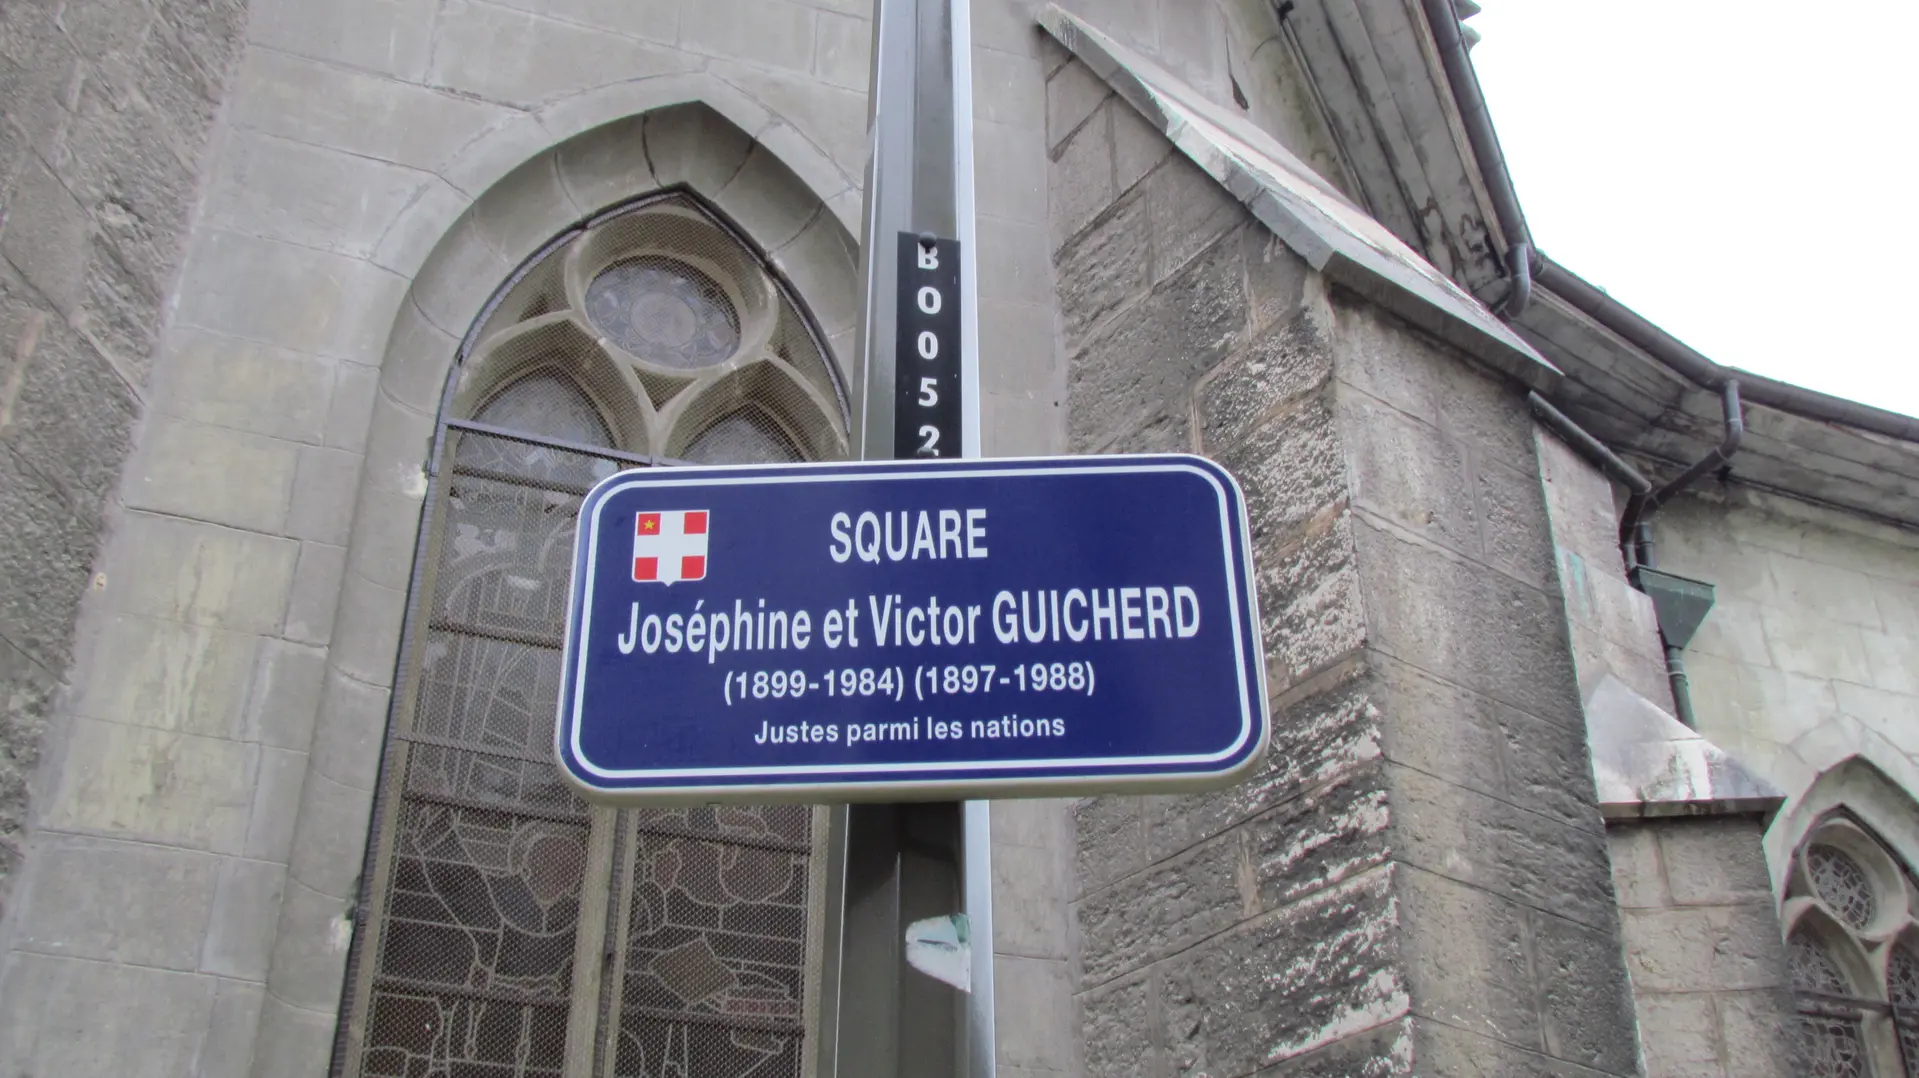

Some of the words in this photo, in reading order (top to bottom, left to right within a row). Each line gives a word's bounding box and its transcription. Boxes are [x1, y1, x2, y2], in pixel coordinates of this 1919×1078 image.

[829, 508, 988, 565] SQUARE
[617, 598, 811, 664] Joséphine
[823, 598, 859, 649] et
[869, 594, 981, 647] Victor
[992, 586, 1201, 644] GUICHERD
[724, 666, 904, 706] (1899-1984)
[915, 661, 1096, 701] (1897-1988)
[754, 720, 839, 744] Justes
[847, 717, 919, 747] parmi
[927, 716, 963, 739] les
[971, 714, 1066, 738] nations
